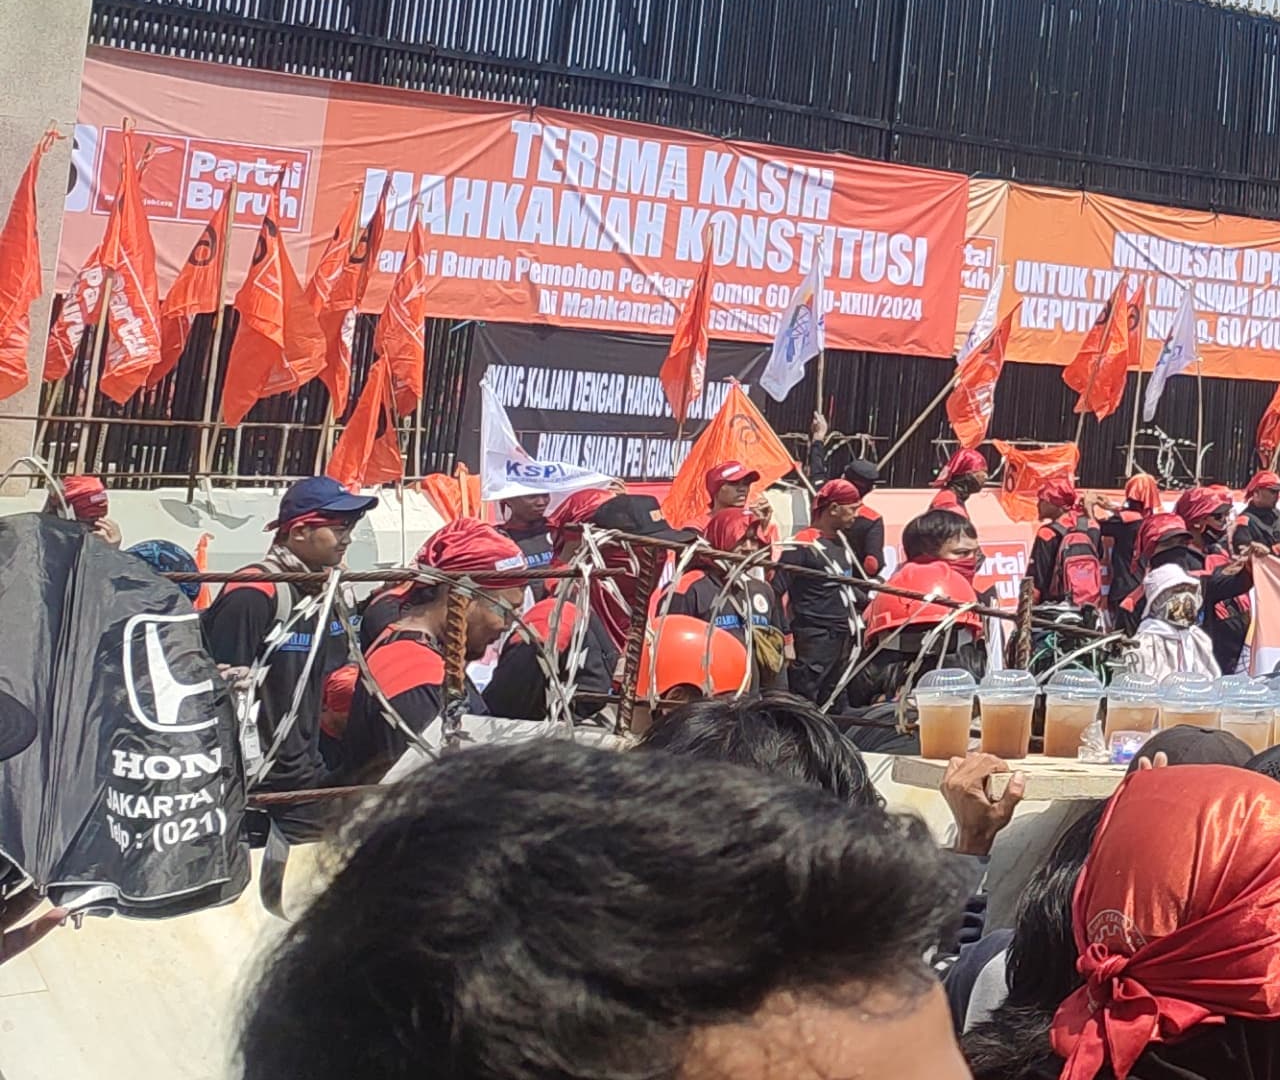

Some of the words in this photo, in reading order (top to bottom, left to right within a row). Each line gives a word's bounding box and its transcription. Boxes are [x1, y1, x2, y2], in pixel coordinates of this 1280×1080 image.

[511, 120, 688, 201] TERIMA
[699, 150, 834, 220] KASIH
[360, 167, 667, 258] MAHKAMAH
[675, 206, 928, 287] KONSTITUSI
[442, 250, 511, 282] Buruh
[515, 256, 614, 292] Pemohon
[711, 281, 762, 306] omor
[1113, 231, 1240, 281] MENDESAK
[561, 294, 675, 327] Mahkamah
[1014, 260, 1088, 299] UNTUK
[1092, 268, 1153, 306] TIA
[1155, 277, 1249, 314] MEAWAN
[524, 367, 575, 411] KALIAN
[572, 371, 625, 414] DENGAR
[624, 375, 664, 418] HARUS
[506, 460, 567, 479] KSPI
[537, 433, 582, 467] BUKAN
[582, 434, 623, 477] SUARA
[106, 786, 214, 819] JAKARTA
[153, 807, 227, 852] (021)
